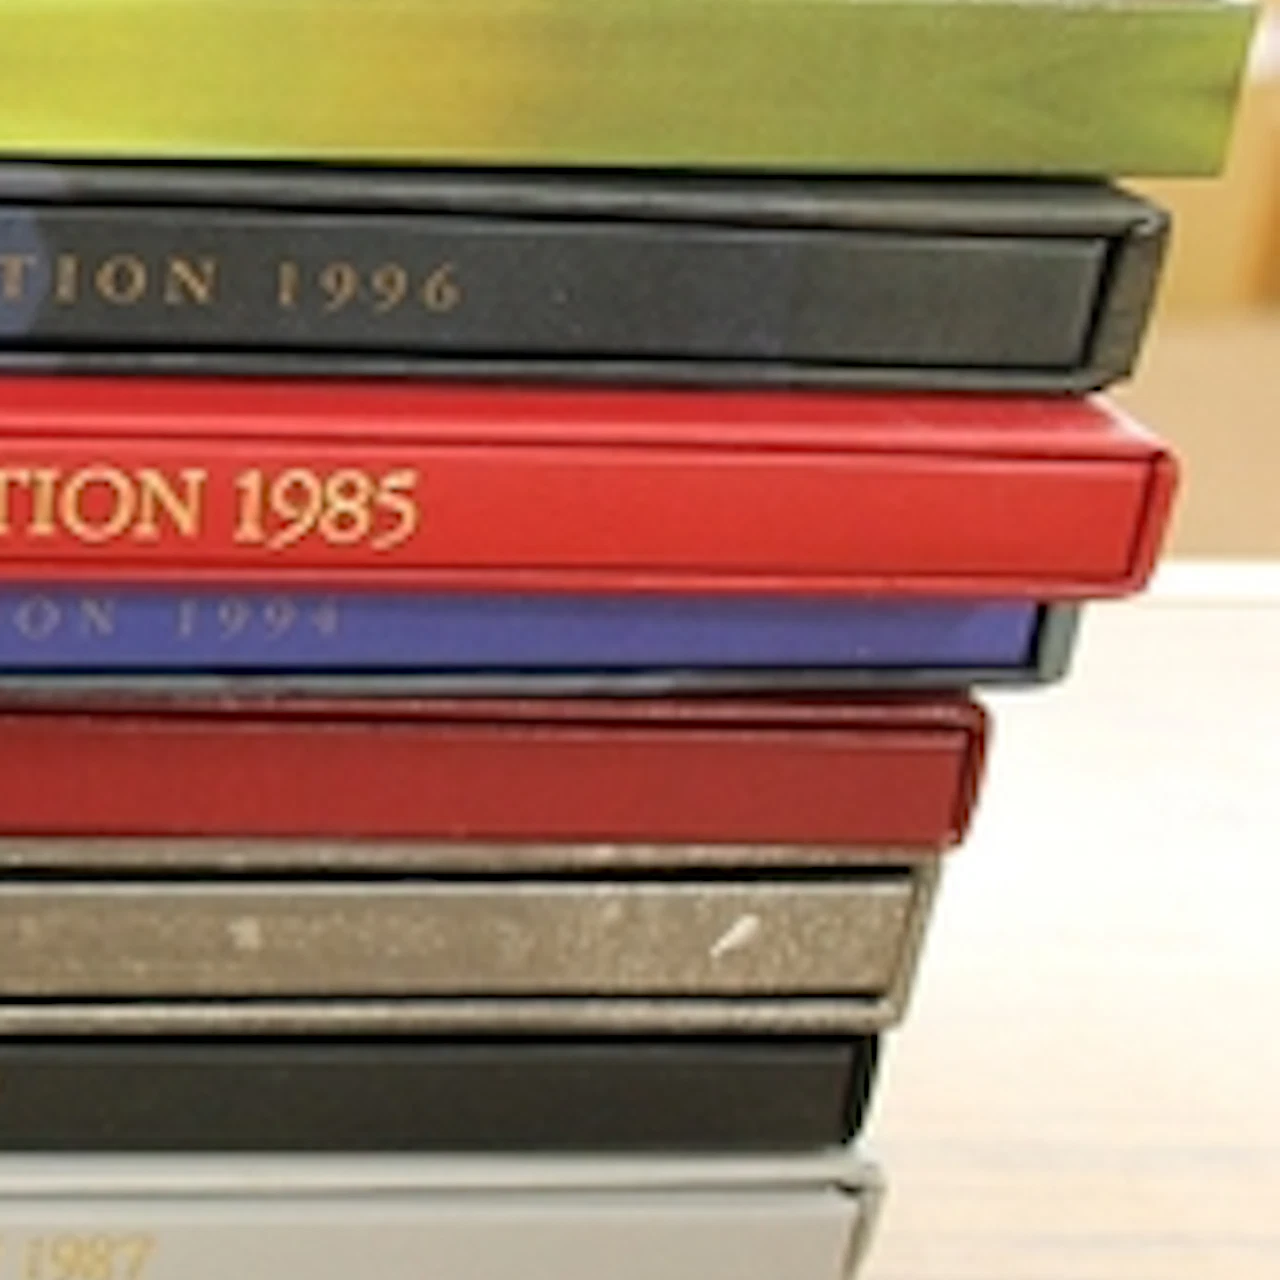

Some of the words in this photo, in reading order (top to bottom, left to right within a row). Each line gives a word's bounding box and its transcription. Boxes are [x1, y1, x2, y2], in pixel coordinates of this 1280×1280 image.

[274, 261, 462, 312] 1996
[234, 468, 418, 549] 1985
[175, 597, 341, 640] 1994
